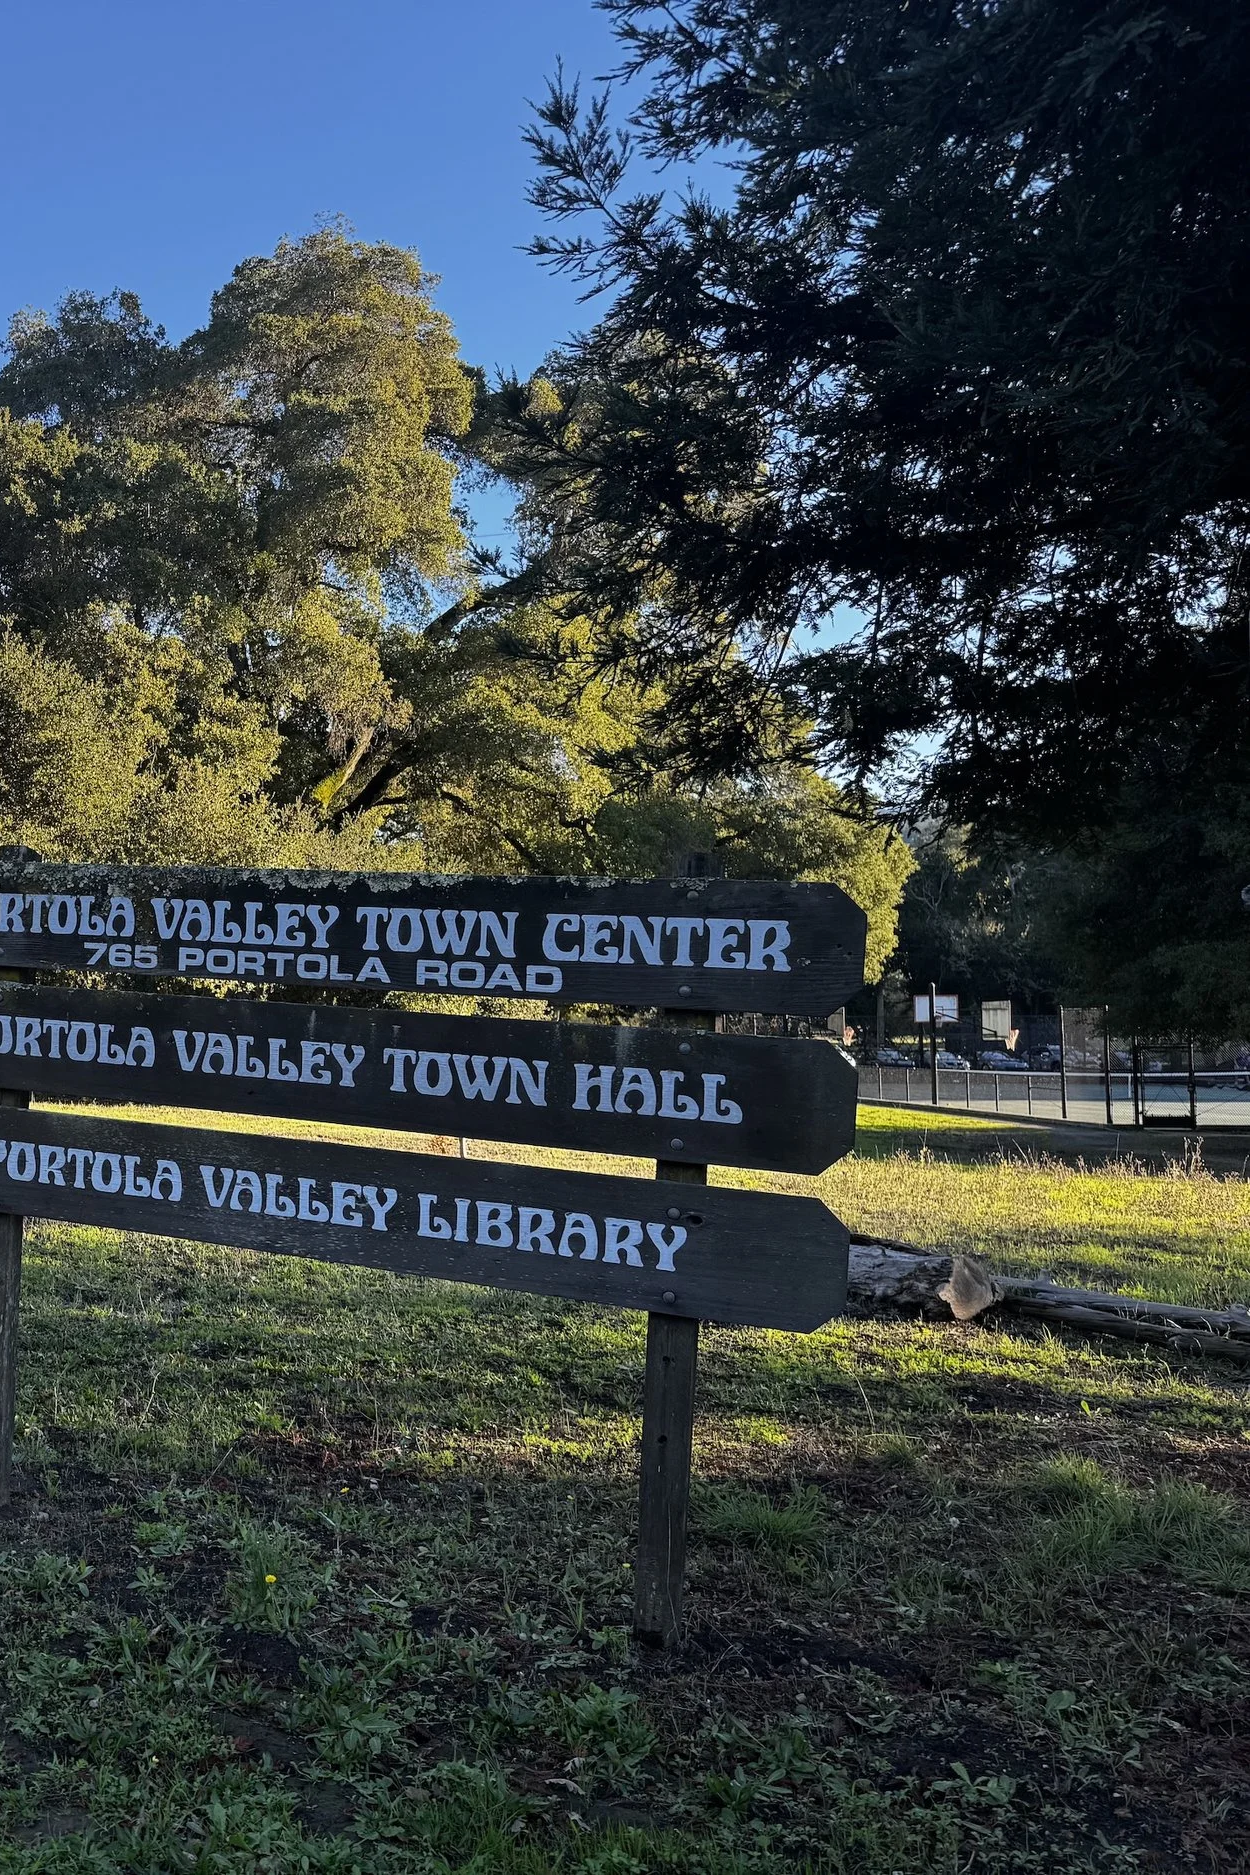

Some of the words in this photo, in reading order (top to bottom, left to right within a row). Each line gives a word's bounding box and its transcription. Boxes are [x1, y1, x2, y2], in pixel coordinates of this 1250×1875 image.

[83, 941, 158, 969] 765
[178, 946, 391, 984] PORTOLA
[416, 959, 563, 993] ROAD
[150, 898, 340, 949] VALLEY
[356, 907, 520, 958] TOWN
[542, 913, 792, 972] CENTER
[172, 1029, 366, 1088] VALLEY
[383, 1047, 549, 1107] TOWN
[571, 1063, 743, 1125] HALL
[199, 1164, 398, 1232] VALLEY
[416, 1192, 688, 1272] LIBRARY
